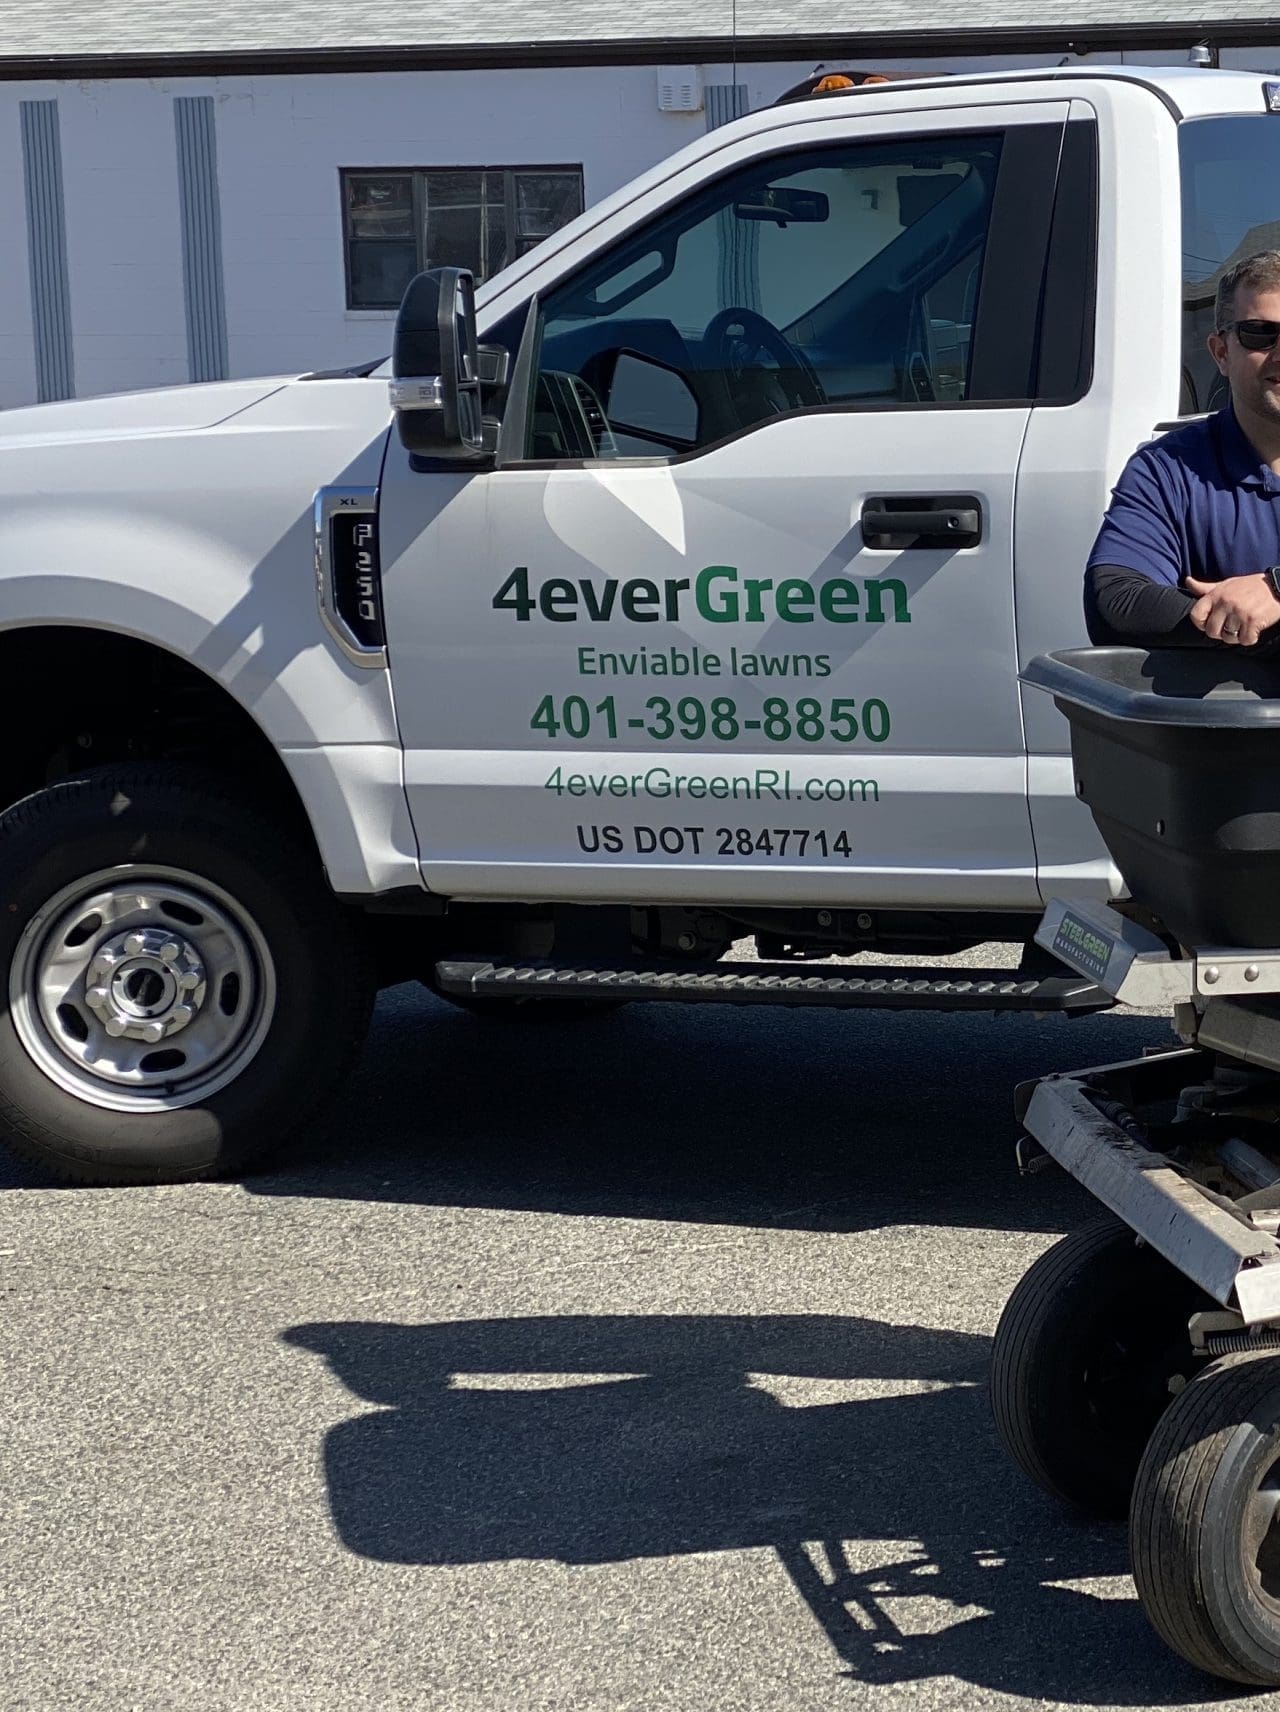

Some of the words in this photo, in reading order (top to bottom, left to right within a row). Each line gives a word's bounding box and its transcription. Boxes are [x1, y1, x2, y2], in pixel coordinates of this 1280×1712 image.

[492, 565, 912, 624] 4everGreen
[578, 646, 721, 677] Enviable
[730, 646, 832, 678] lawns
[530, 694, 892, 744] 401-398-8850
[544, 766, 880, 803] 4everGreenRI.com
[576, 825, 624, 854] US
[635, 826, 704, 856] DOT
[716, 828, 853, 858] 2847714
